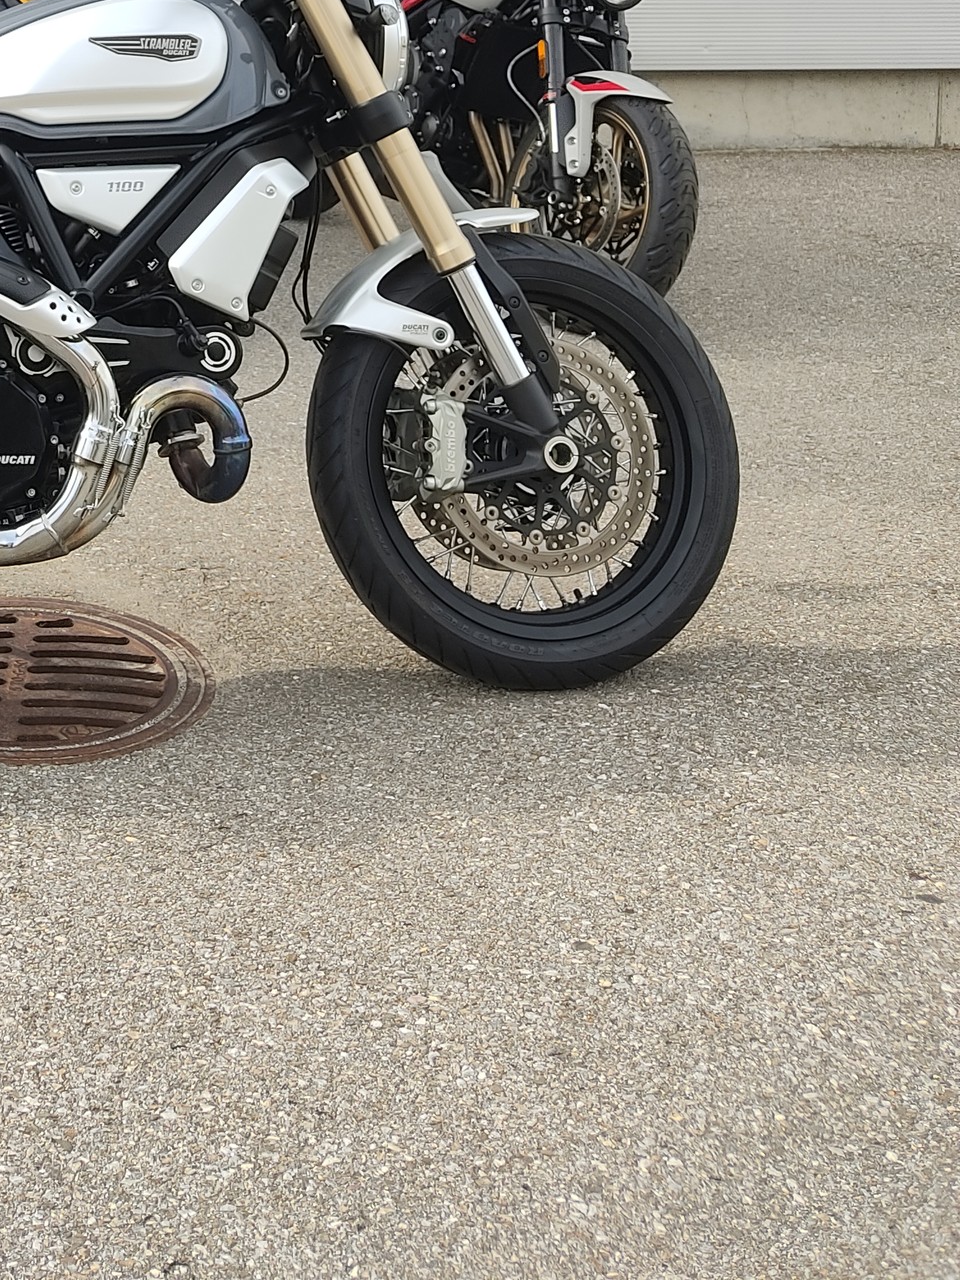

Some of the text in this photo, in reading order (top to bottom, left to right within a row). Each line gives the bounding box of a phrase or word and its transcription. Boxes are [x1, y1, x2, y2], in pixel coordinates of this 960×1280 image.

[140, 37, 191, 50] SCRAMBLER
[106, 181, 144, 193] 1100
[445, 420, 456, 472] brembo
